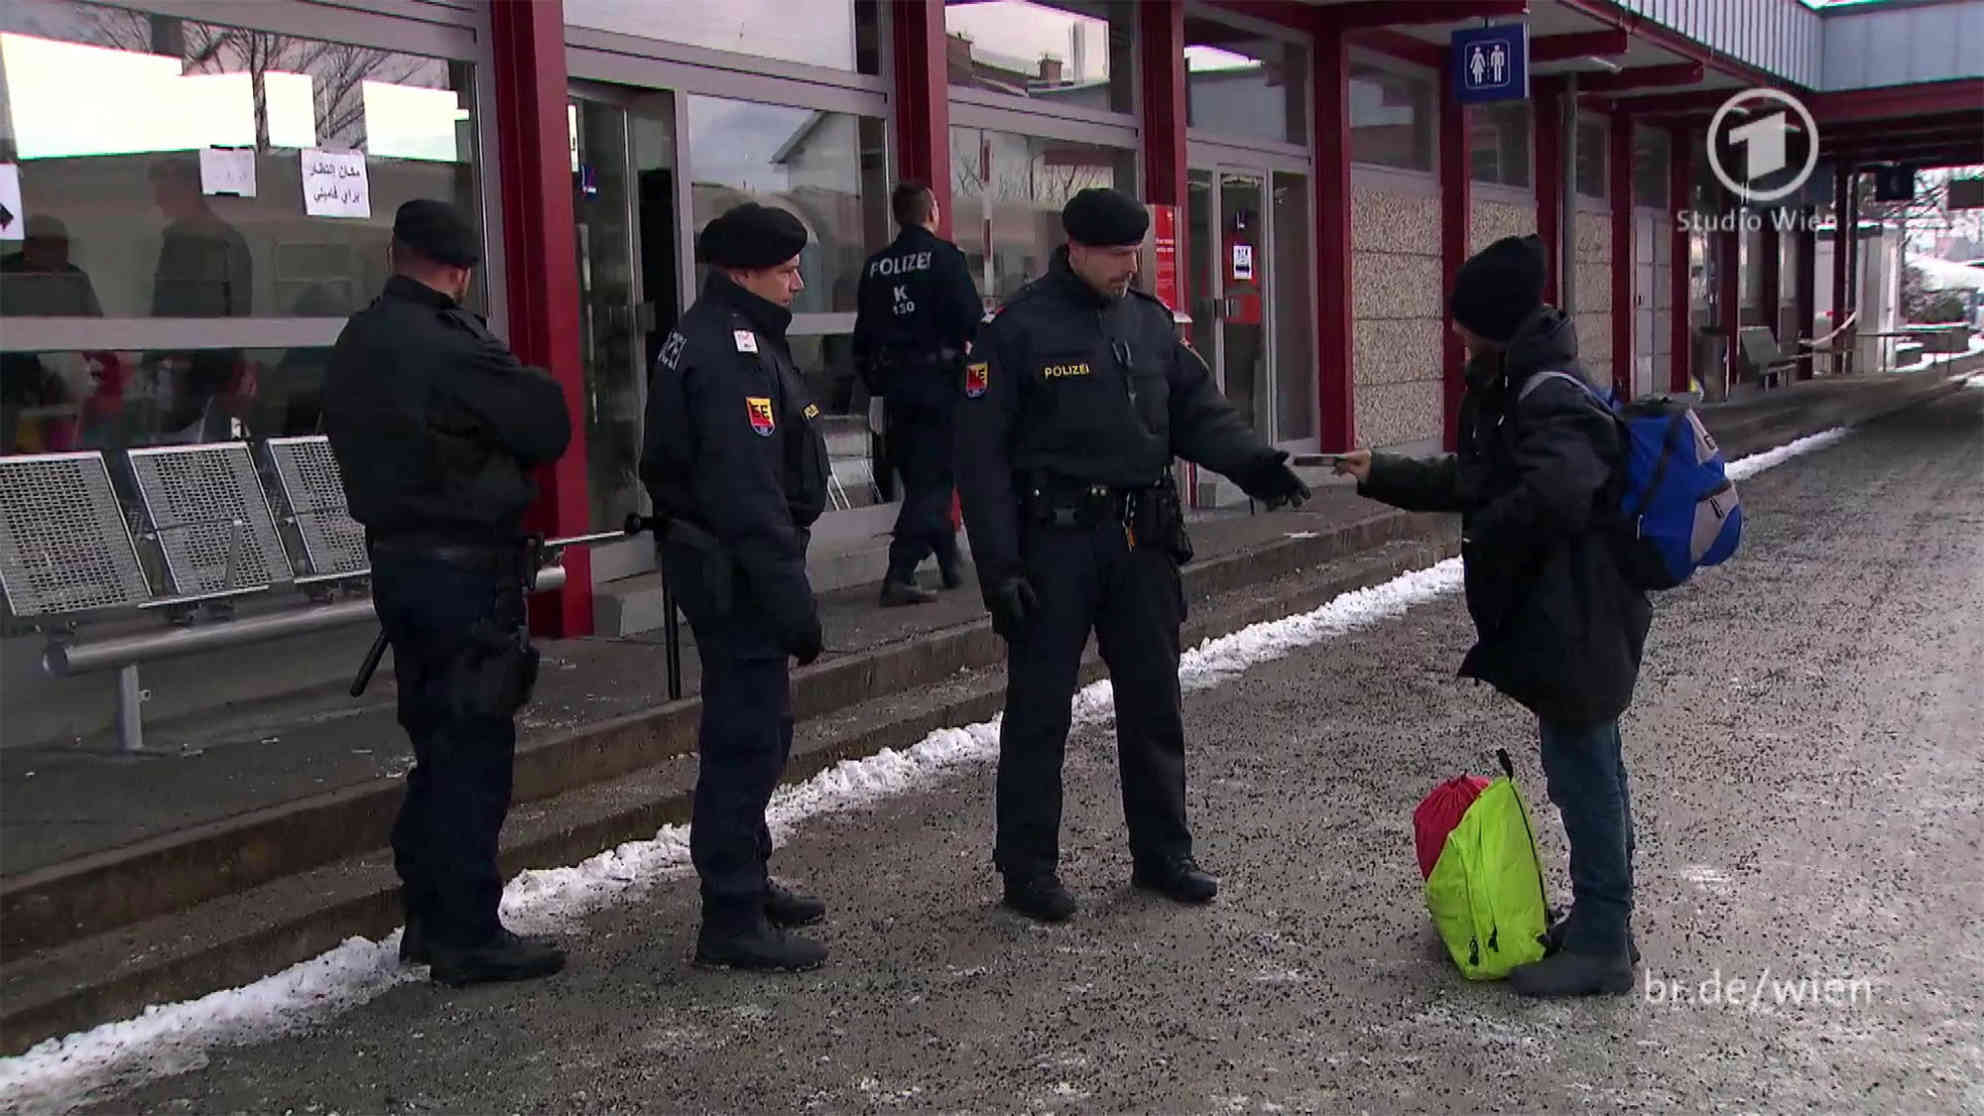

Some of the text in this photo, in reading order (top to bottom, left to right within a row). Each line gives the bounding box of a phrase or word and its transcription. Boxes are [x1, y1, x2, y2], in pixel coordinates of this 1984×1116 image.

[869, 251, 932, 279] POLIZEI
[893, 285, 908, 302] K
[1044, 362, 1090, 380] POLIZEI
